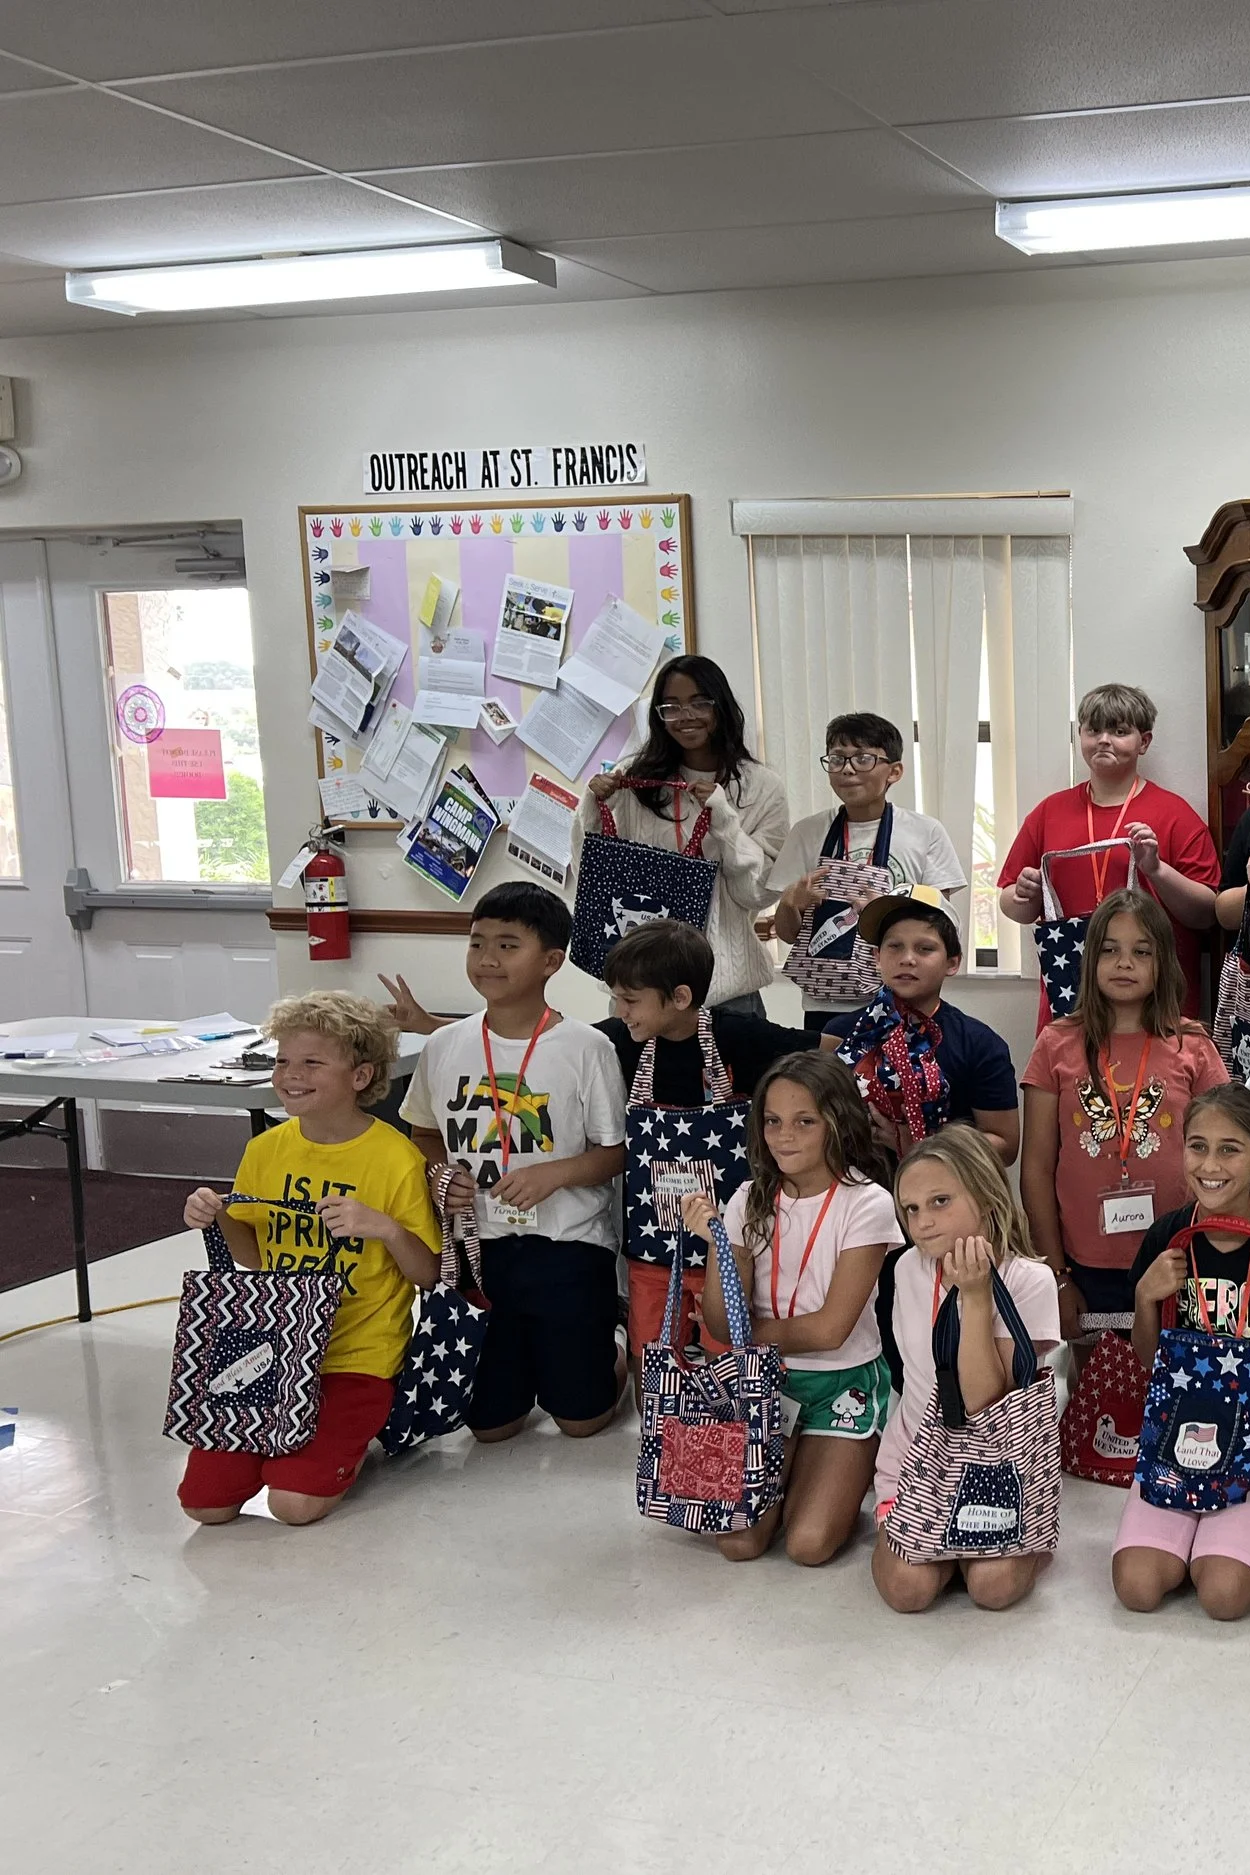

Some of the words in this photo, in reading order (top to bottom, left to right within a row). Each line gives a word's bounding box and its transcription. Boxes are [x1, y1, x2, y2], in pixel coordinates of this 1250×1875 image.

[370, 451, 467, 491] OUTREACH
[481, 450, 500, 488] AT
[510, 448, 539, 486] ST.
[552, 443, 638, 486] FRANCIS
[508, 577, 524, 588] Seek
[530, 583, 549, 595] Serve
[443, 797, 472, 825] CAMP
[432, 805, 483, 853] WINGMANN
[283, 1173, 311, 1202] IS
[660, 1175, 681, 1184] HOME
[1111, 1212, 1145, 1223] Aurora
[267, 1210, 364, 1254] PRIG
[226, 1365, 243, 1382] Bless
[253, 1357, 272, 1374] USA
[663, 1395, 676, 1415] USA
[1094, 1438, 1107, 1451] WE
[1107, 1444, 1135, 1455] STAND
[1102, 1430, 1130, 1447] UNITED
[1176, 1446, 1198, 1455] Land
[1187, 1458, 1208, 1467] Love
[967, 1507, 998, 1518] HOME
[1000, 1510, 1013, 1519] OF
[960, 1521, 980, 1529] THE
[983, 1520, 1016, 1530] BRAVE
